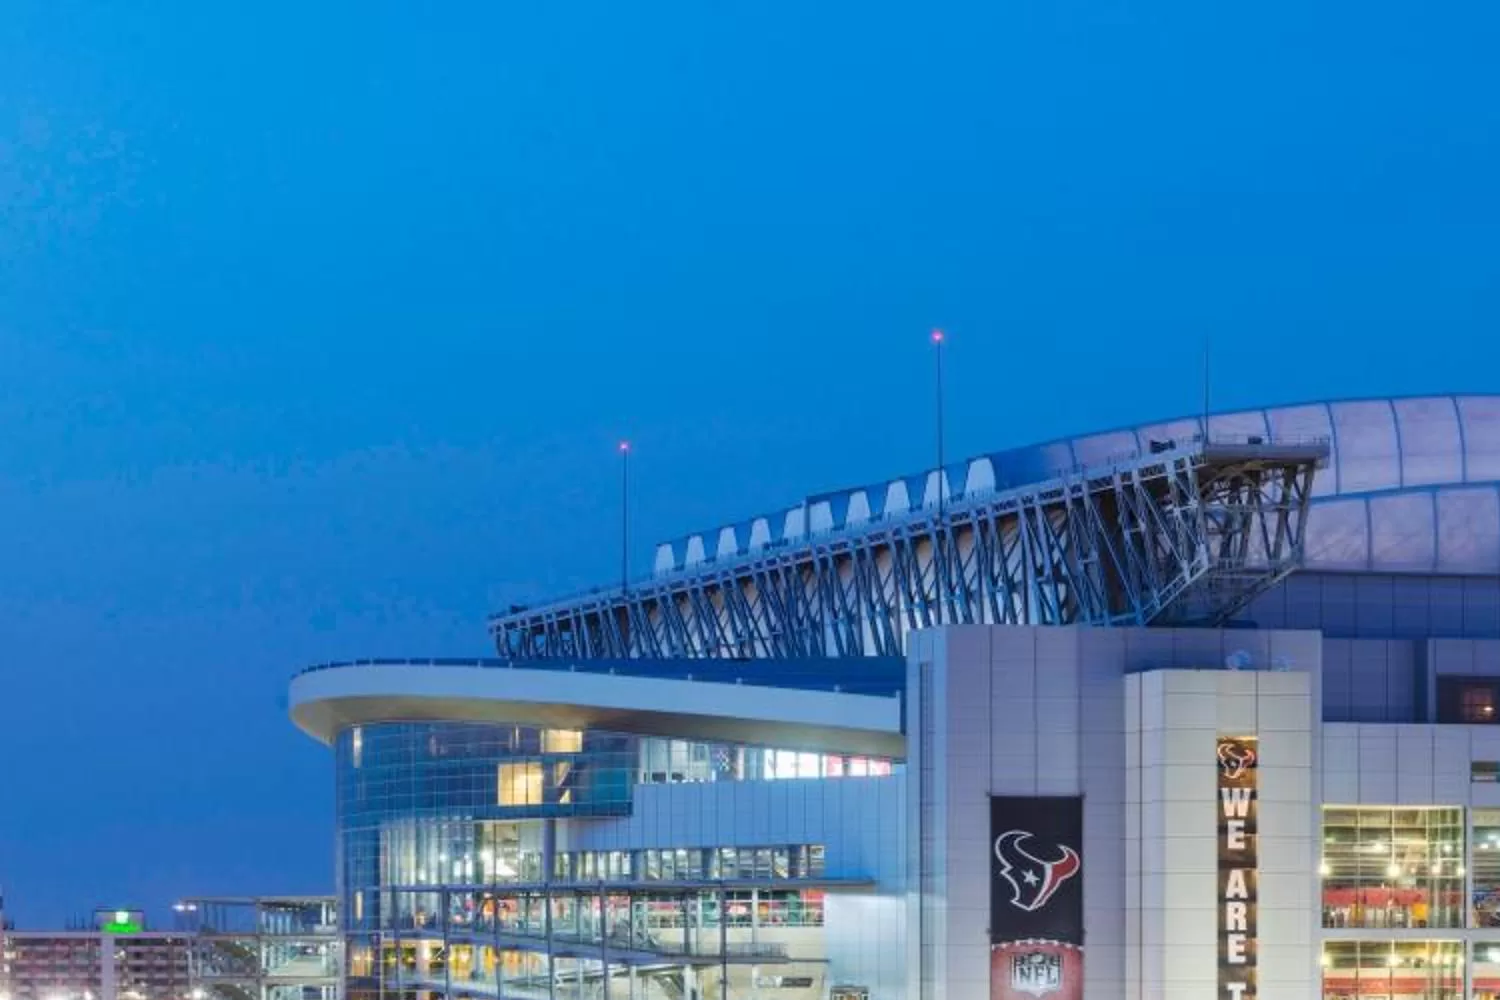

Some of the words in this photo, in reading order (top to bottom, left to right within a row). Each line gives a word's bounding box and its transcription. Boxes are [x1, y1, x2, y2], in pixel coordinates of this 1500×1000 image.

[1220, 787, 1252, 850] WE
[1225, 868, 1249, 964] ARE
[1019, 966, 1058, 984] NFL
